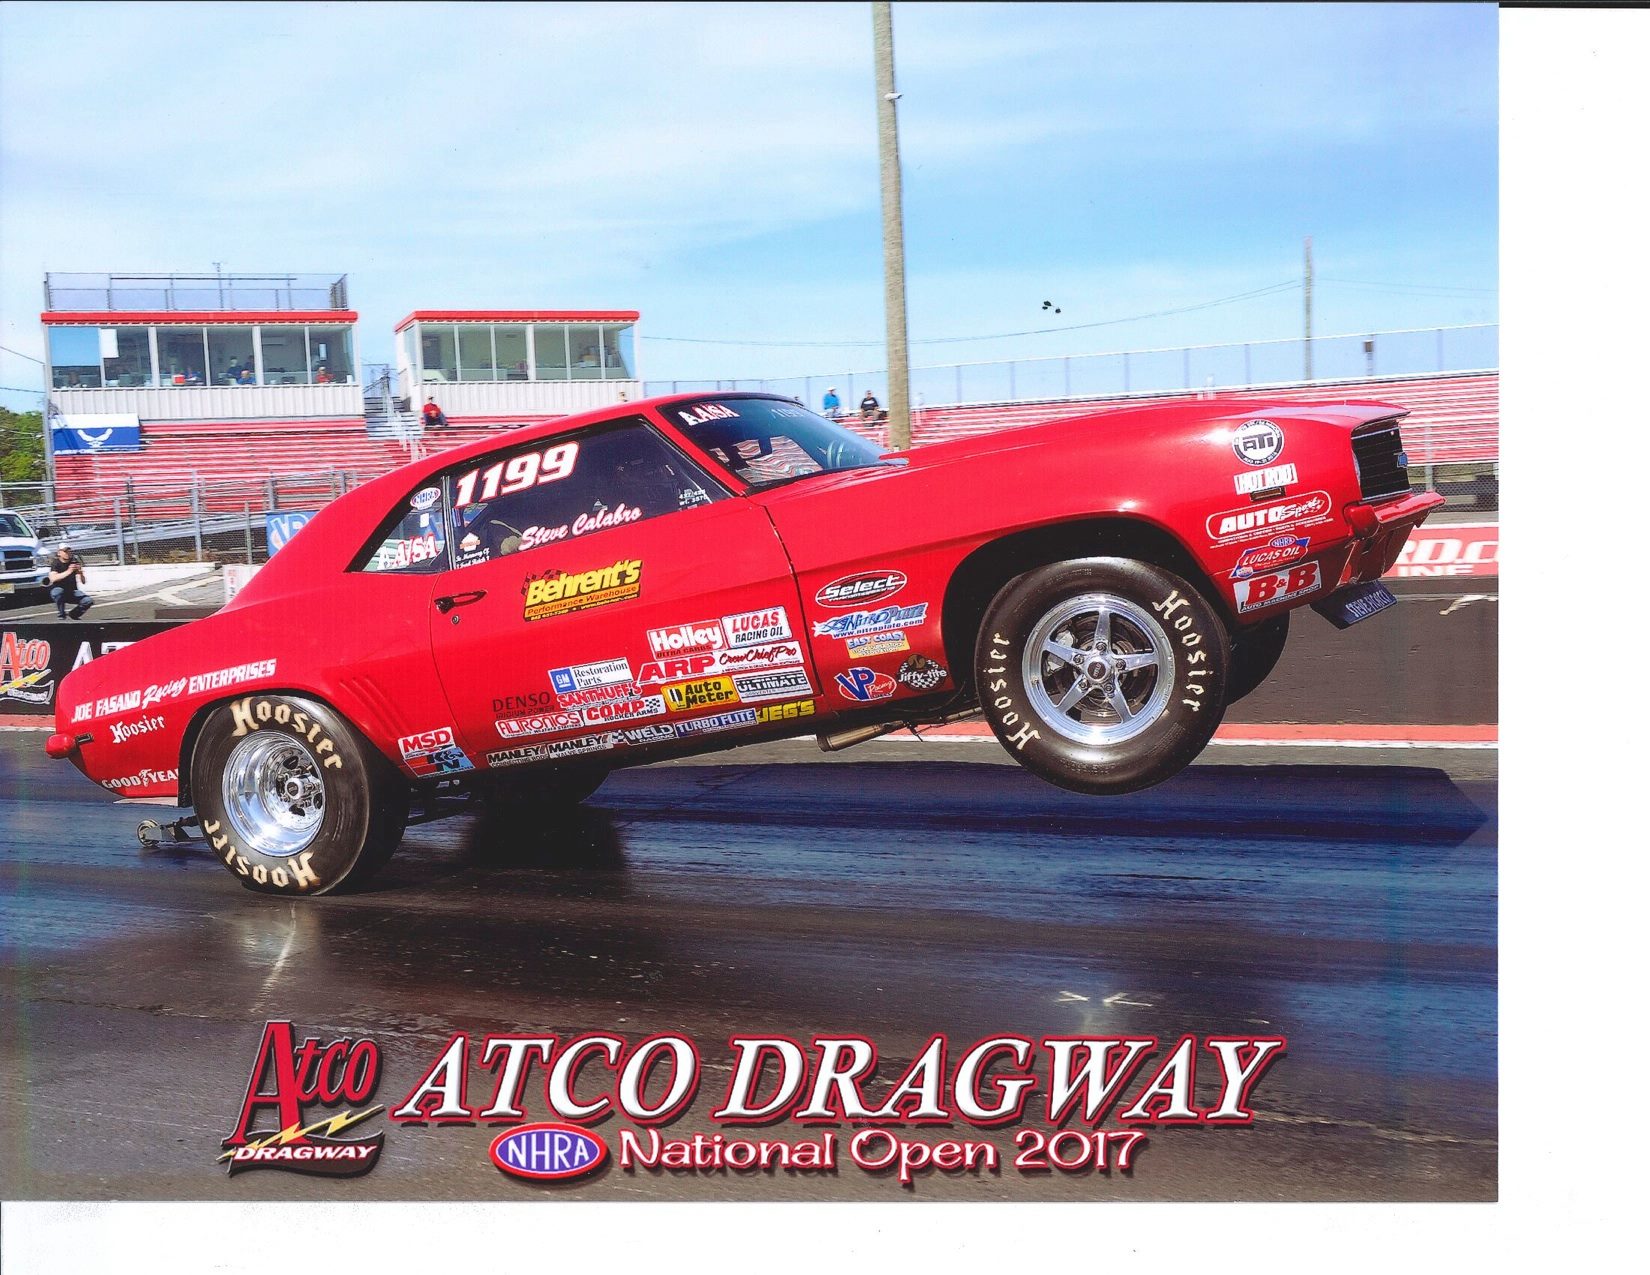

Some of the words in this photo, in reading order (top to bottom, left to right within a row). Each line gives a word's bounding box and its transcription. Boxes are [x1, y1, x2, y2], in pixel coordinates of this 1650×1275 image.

[455, 441, 580, 508] 1199
[518, 525, 569, 551] Steve
[571, 502, 643, 538] Calabro
[1271, 535, 1296, 548] NHRA
[1242, 549, 1282, 566] LUCAS
[1282, 546, 1300, 558] OIL
[525, 559, 643, 606] Behrent's
[825, 575, 900, 599] Select
[1245, 563, 1319, 606] B&B
[527, 597, 584, 616] Performance
[585, 585, 637, 603] Warehouse
[1241, 602, 1262, 612] AUTO
[731, 611, 780, 634] LUCAS
[833, 619, 923, 638] www.nitroplate.com
[650, 625, 723, 652] Holley
[735, 628, 768, 643] RACING
[769, 626, 783, 637] OIL
[847, 636, 872, 649] EAST
[874, 631, 906, 642] COAST
[1152, 590, 1215, 713] Hoosier
[555, 673, 570, 685] GM
[573, 661, 628, 678] Restoration
[640, 655, 716, 682] ARP
[71, 702, 94, 724] JOE
[95, 690, 141, 717] FASANO
[142, 676, 188, 710] Racing
[188, 658, 278, 695] ENTERPRISES
[576, 677, 602, 687] Parts
[685, 680, 722, 697] Auto
[736, 674, 807, 692] ULTIMATE
[836, 668, 875, 699] VP
[868, 681, 893, 694] Racing
[983, 632, 1042, 750] Hoosier
[492, 692, 551, 713] DENSO
[557, 681, 643, 708] SANTHUFF'S
[685, 690, 734, 709] Meter
[496, 710, 526, 720] IRIDIUM
[527, 705, 555, 715] POWER
[586, 700, 645, 721] COMP
[604, 712, 635, 722] ROCKER
[635, 707, 659, 717] ARMS
[677, 717, 720, 734] TURBO
[721, 709, 756, 725] FLITE
[756, 699, 815, 723] JEG'S
[109, 714, 165, 744] Hoosier
[231, 696, 343, 770] Hoosier
[625, 724, 675, 741] WELD
[402, 730, 451, 753] MSD
[549, 735, 603, 754] MANLEY
[487, 744, 542, 764] MANLEY
[101, 768, 178, 790] GOODYEA
[204, 819, 321, 889] Hoosier
